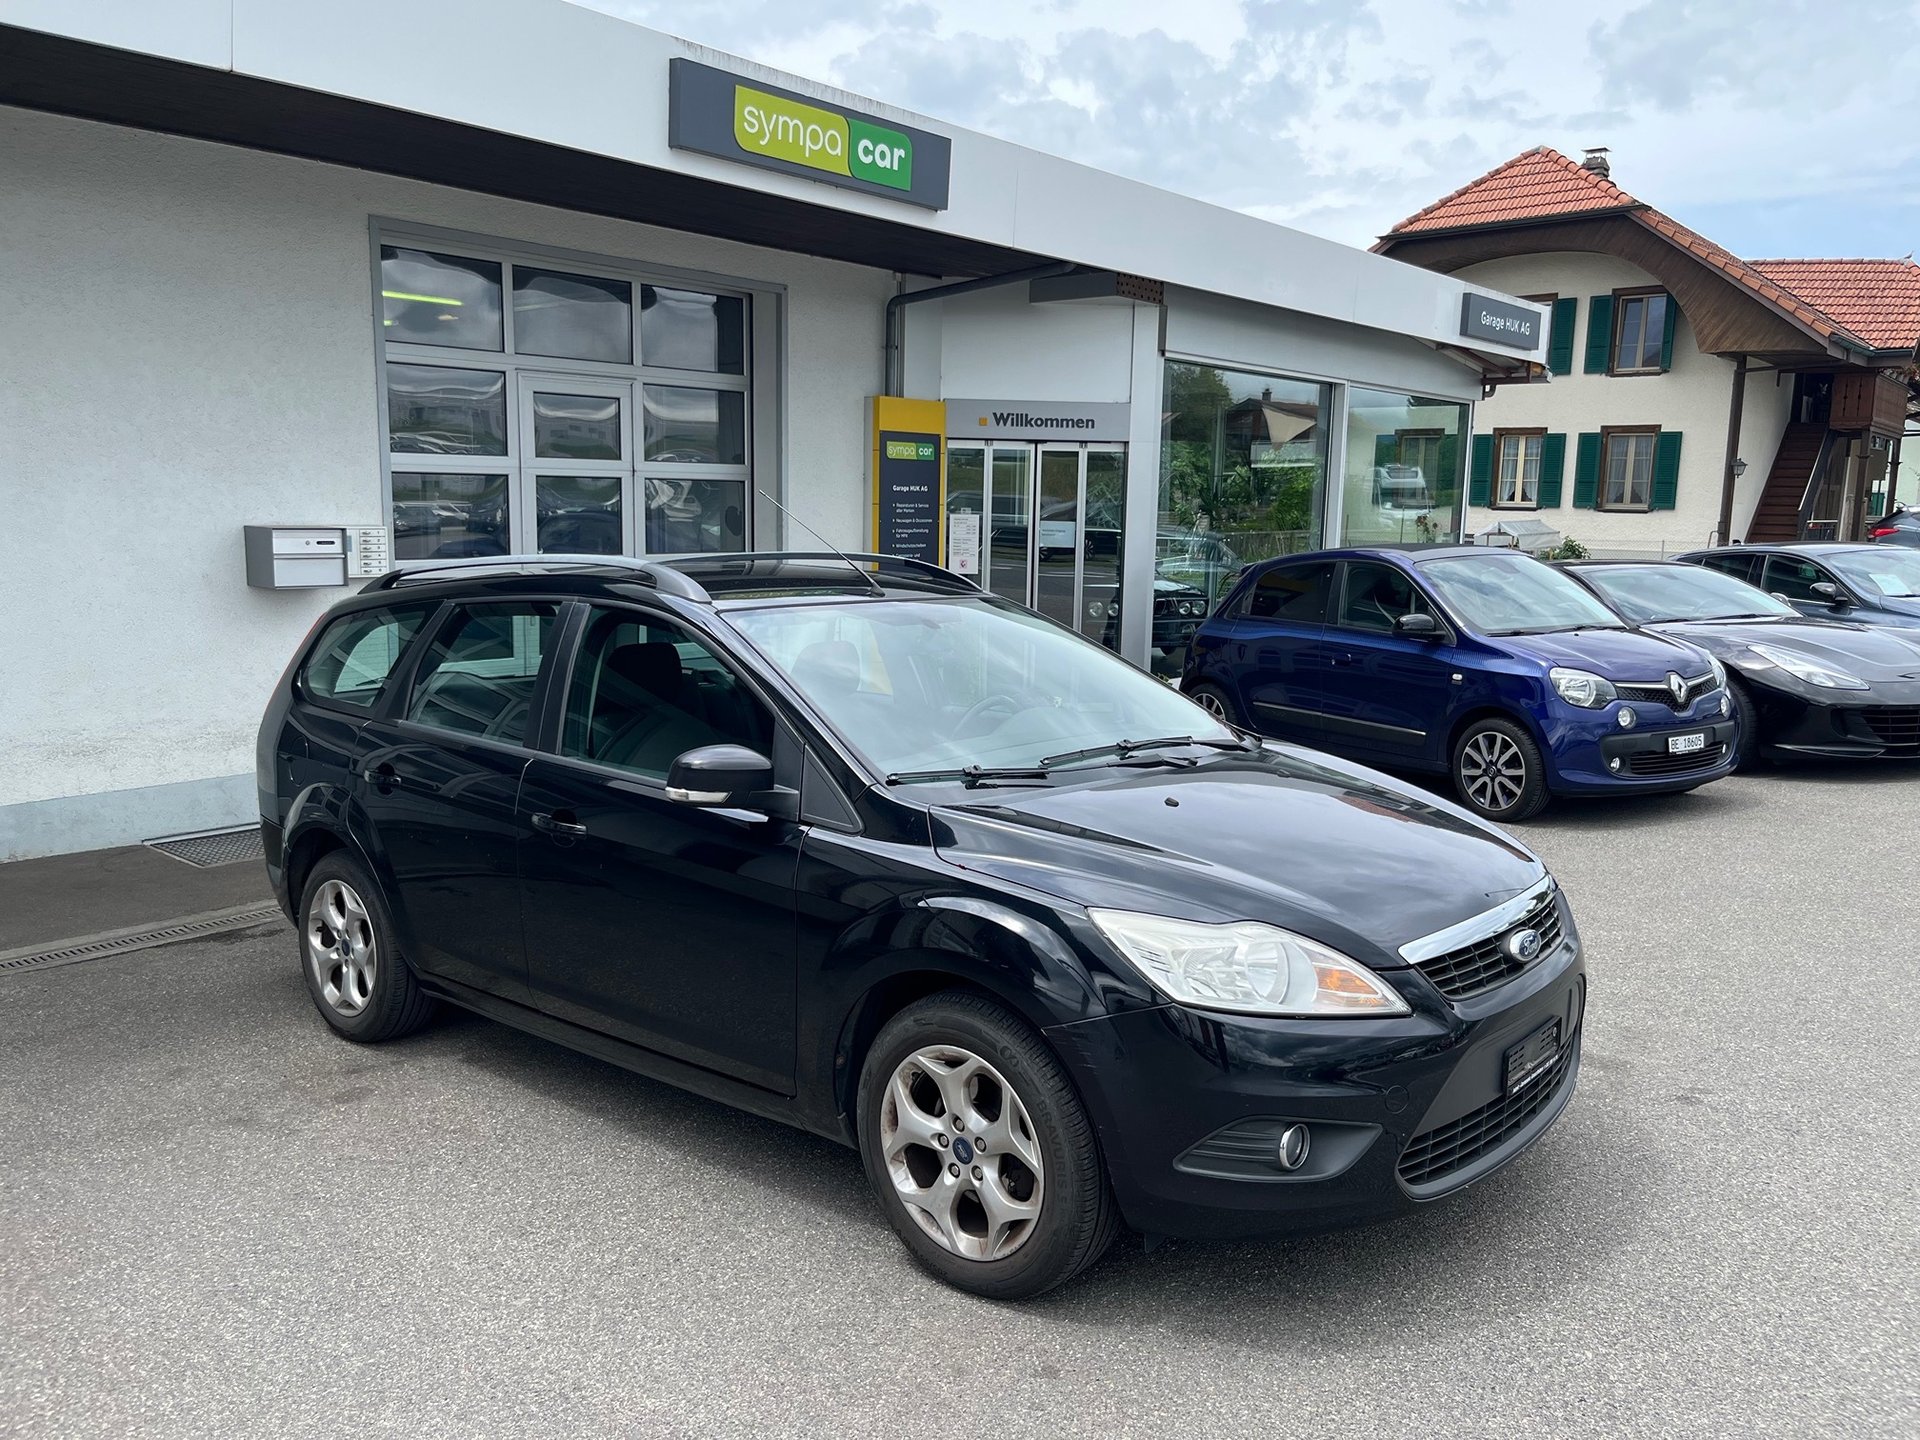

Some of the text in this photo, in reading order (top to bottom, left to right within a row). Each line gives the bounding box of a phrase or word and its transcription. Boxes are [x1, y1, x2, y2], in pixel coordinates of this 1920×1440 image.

[743, 106, 905, 171] sympa car
[1481, 311, 1531, 336] Garage HUK AG
[992, 412, 1095, 429] Willkommen
[887, 445, 933, 457] sympa car
[1671, 736, 1702, 750] BE 18605
